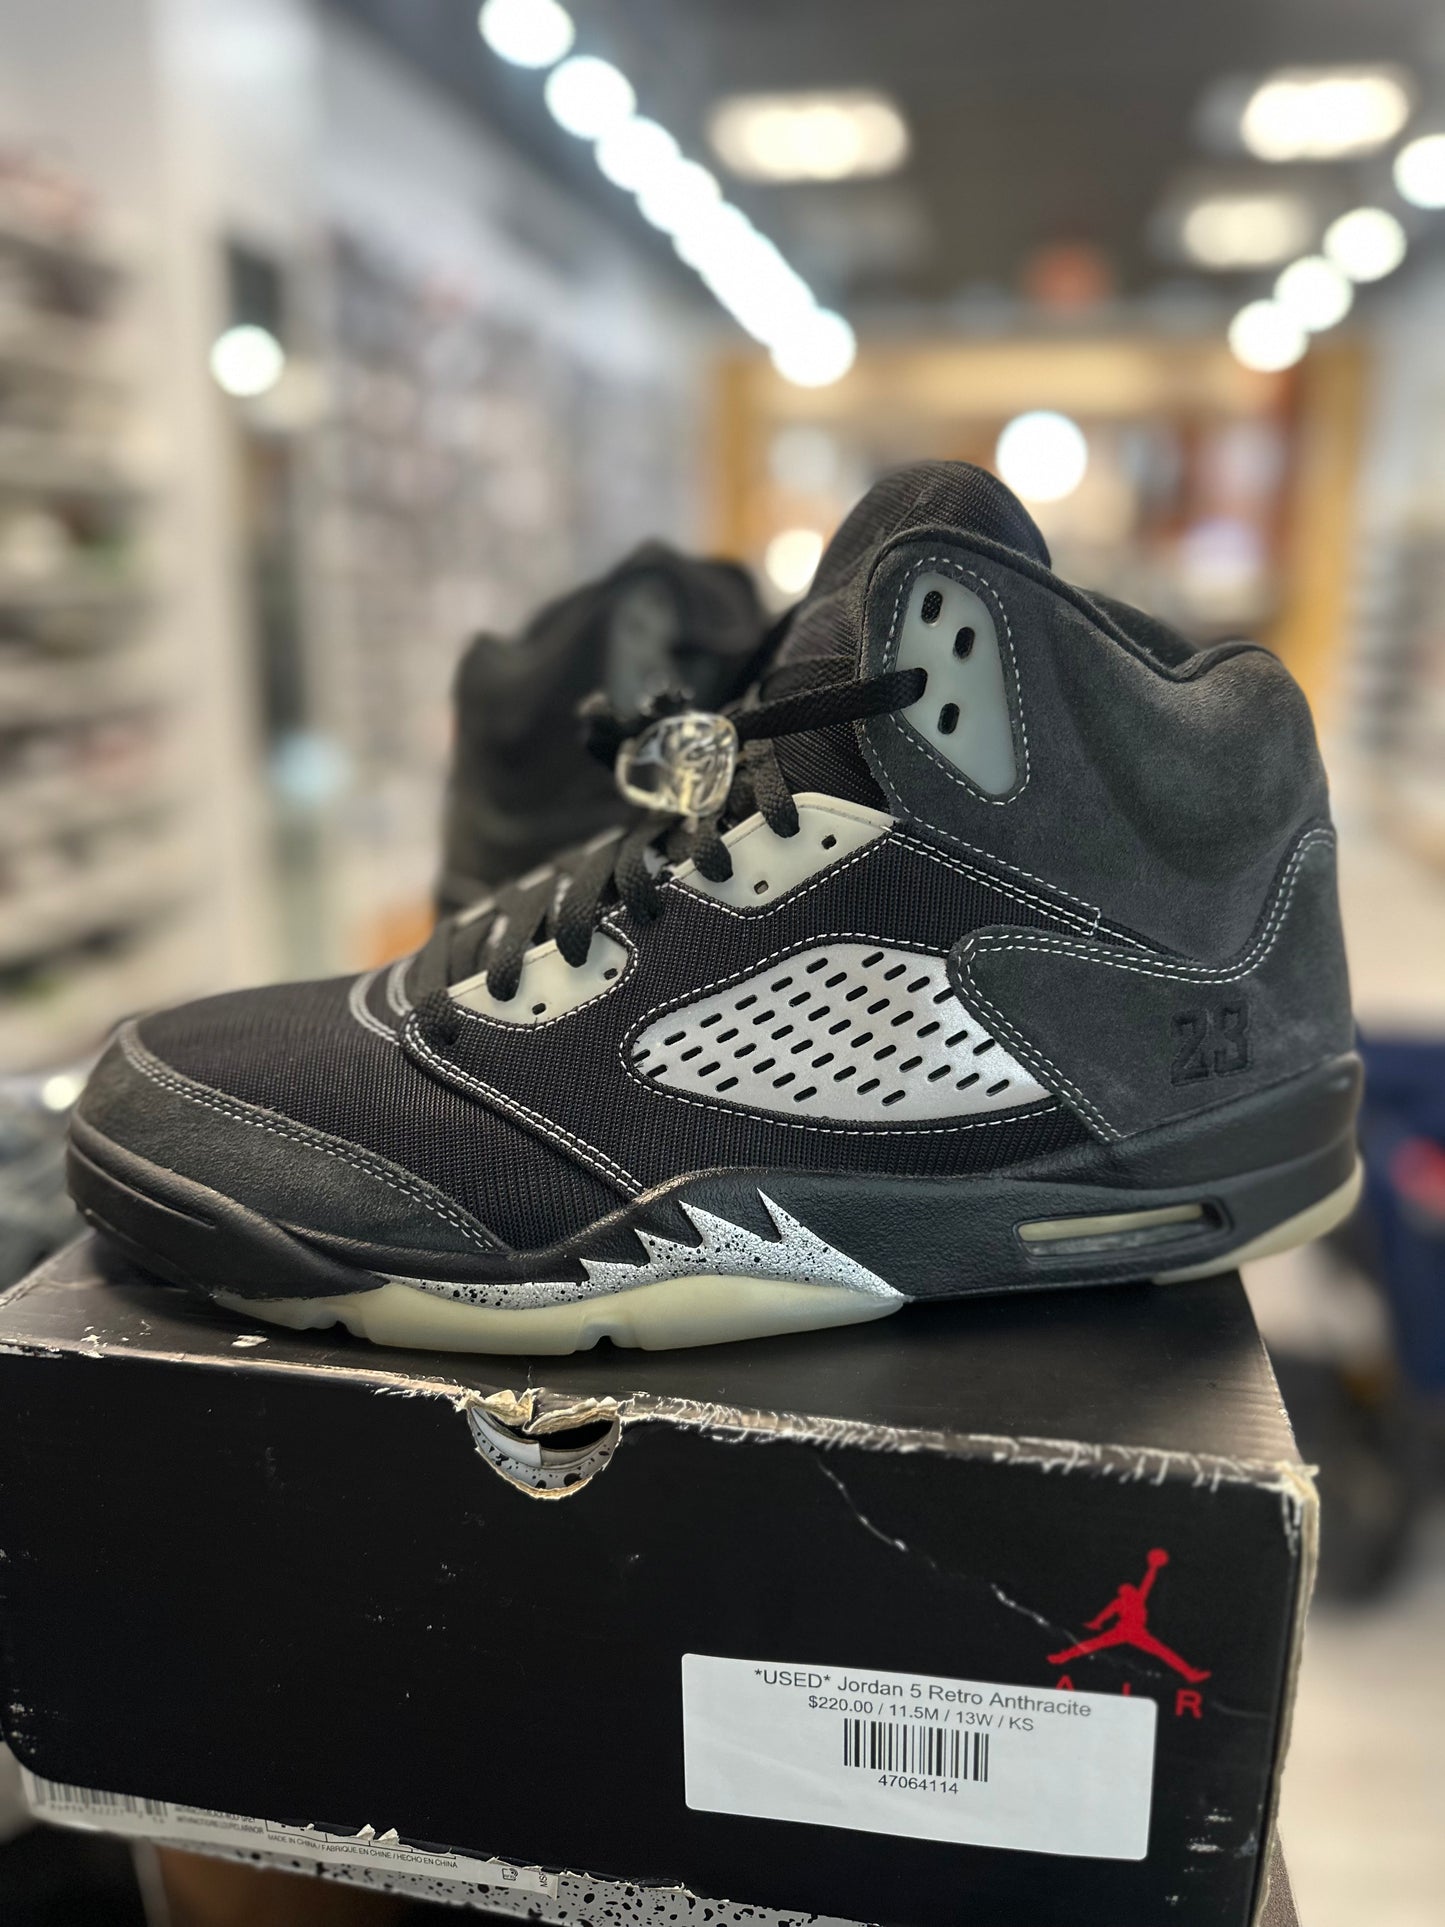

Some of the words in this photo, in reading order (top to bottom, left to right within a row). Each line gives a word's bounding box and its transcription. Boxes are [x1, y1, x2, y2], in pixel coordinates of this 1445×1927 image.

[1169, 1001, 1249, 1086] 23
[808, 1695, 873, 1714] $220.00
[878, 1703, 884, 1716] /
[889, 1704, 939, 1721] 11.5M
[944, 1708, 951, 1722] /
[956, 1711, 993, 1727] 13W
[997, 1715, 1004, 1728] /
[1009, 1717, 1034, 1732] KS
[838, 1676, 903, 1697] Jordan
[910, 1683, 922, 1699] 5
[928, 1685, 983, 1705] Retro
[989, 1692, 1092, 1717] Anthracite
[878, 1774, 959, 1795] 47064114
[267, 1834, 287, 1843] MADE
[296, 1838, 317, 1849] CHINA
[358, 1847, 369, 1855] EN
[396, 1853, 422, 1863] HECHO
[423, 1857, 434, 1865] EN
[434, 1859, 458, 1868] CHINA
